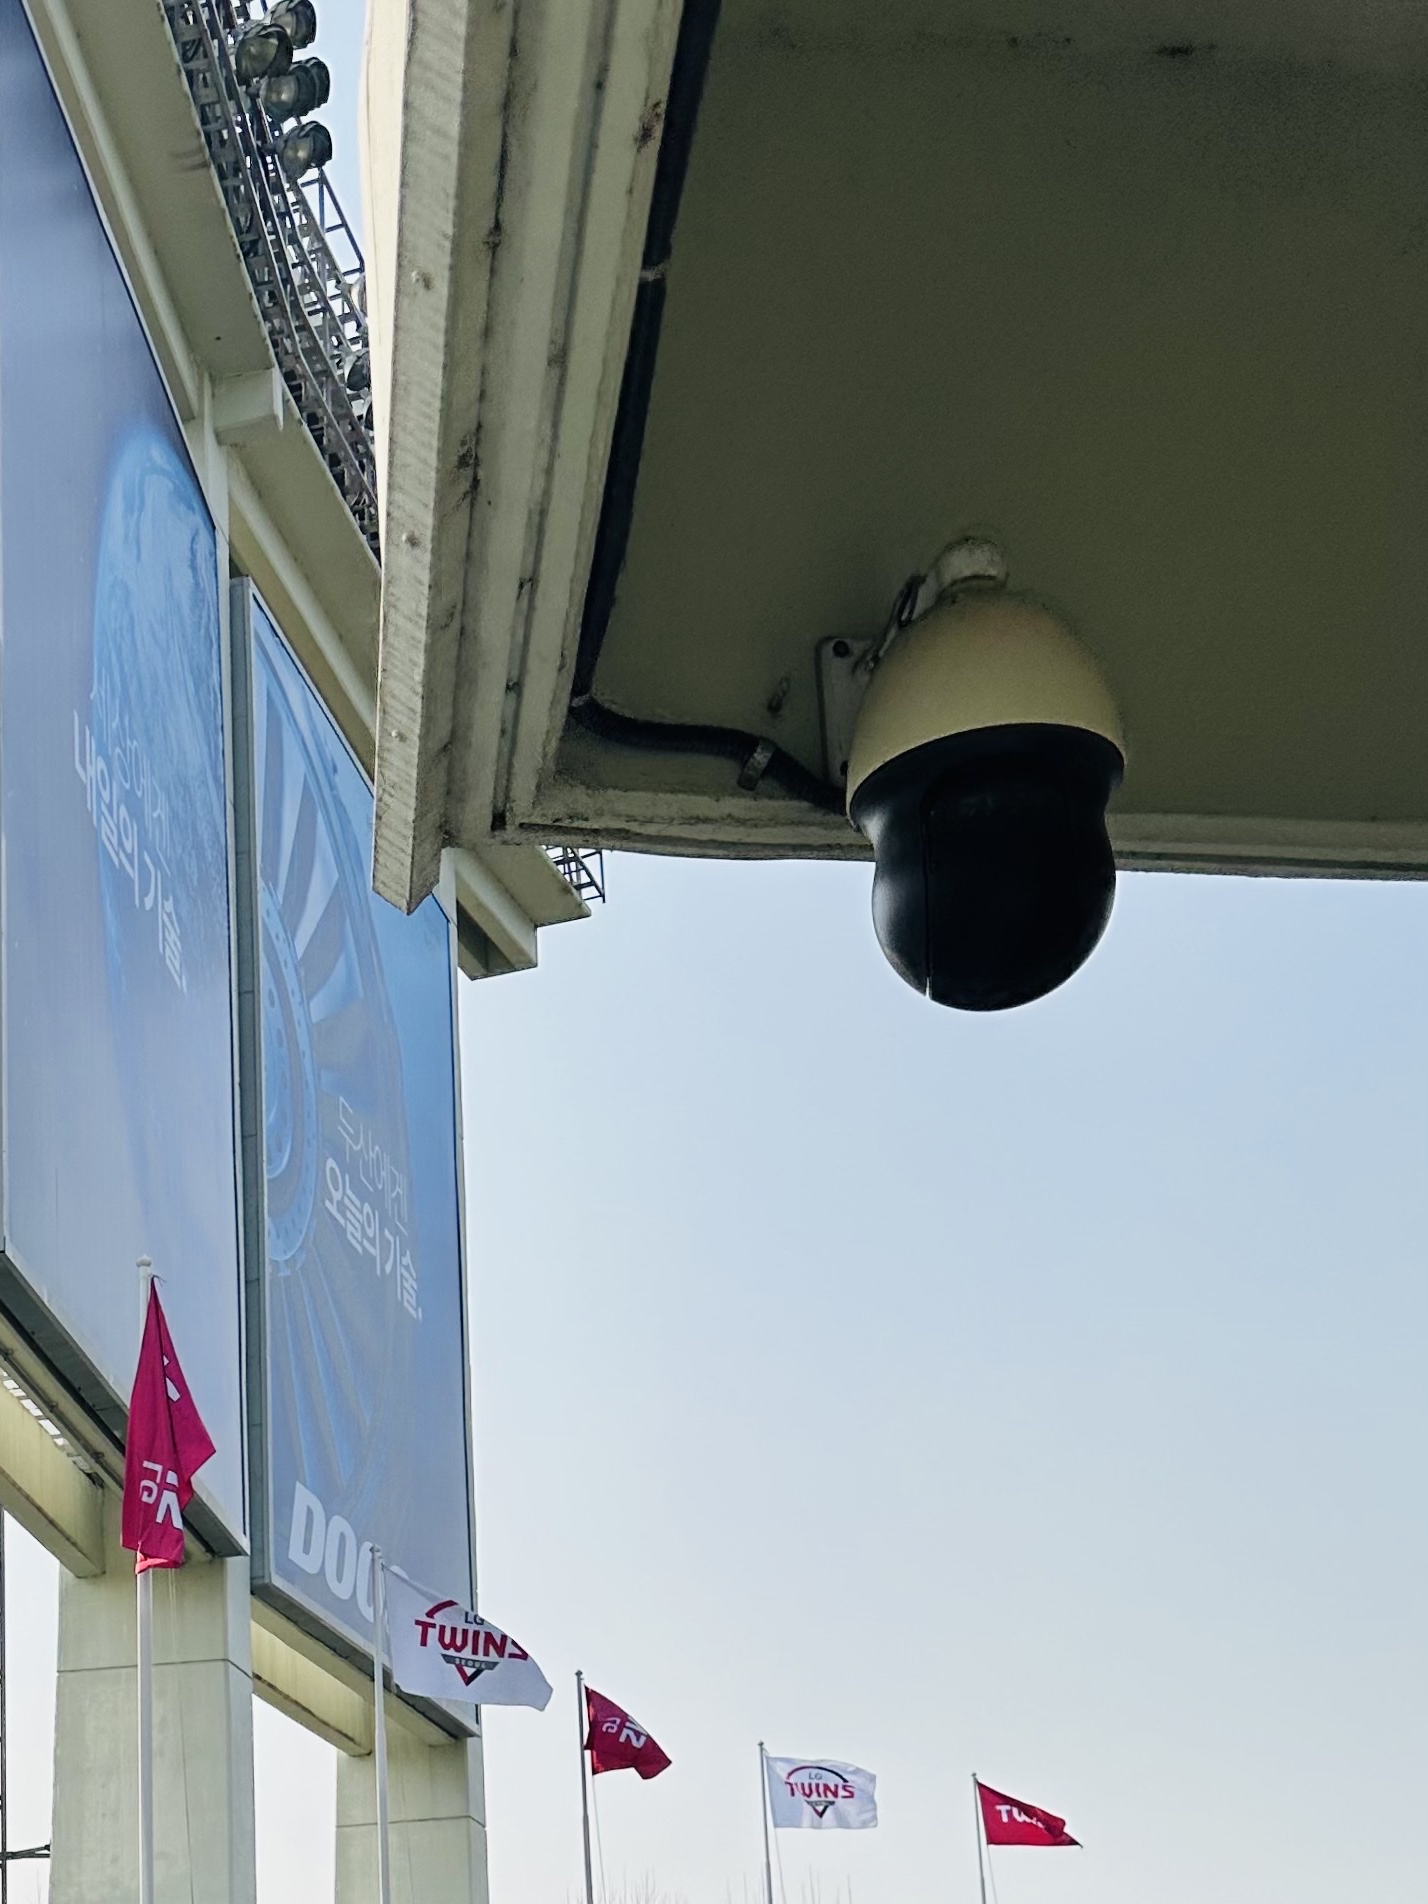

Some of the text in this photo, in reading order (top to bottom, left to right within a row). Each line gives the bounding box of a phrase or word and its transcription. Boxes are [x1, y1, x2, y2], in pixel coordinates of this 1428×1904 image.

[73, 709, 187, 993] 내일의 기술.
[338, 1095, 409, 1236] 두산에겐
[324, 1157, 422, 1321] 오늘의 기술.
[465, 1611, 484, 1625] LG
[414, 1619, 529, 1661] TWINS
[454, 1657, 486, 1669] SEOUL
[784, 1781, 856, 1799] TWINS
